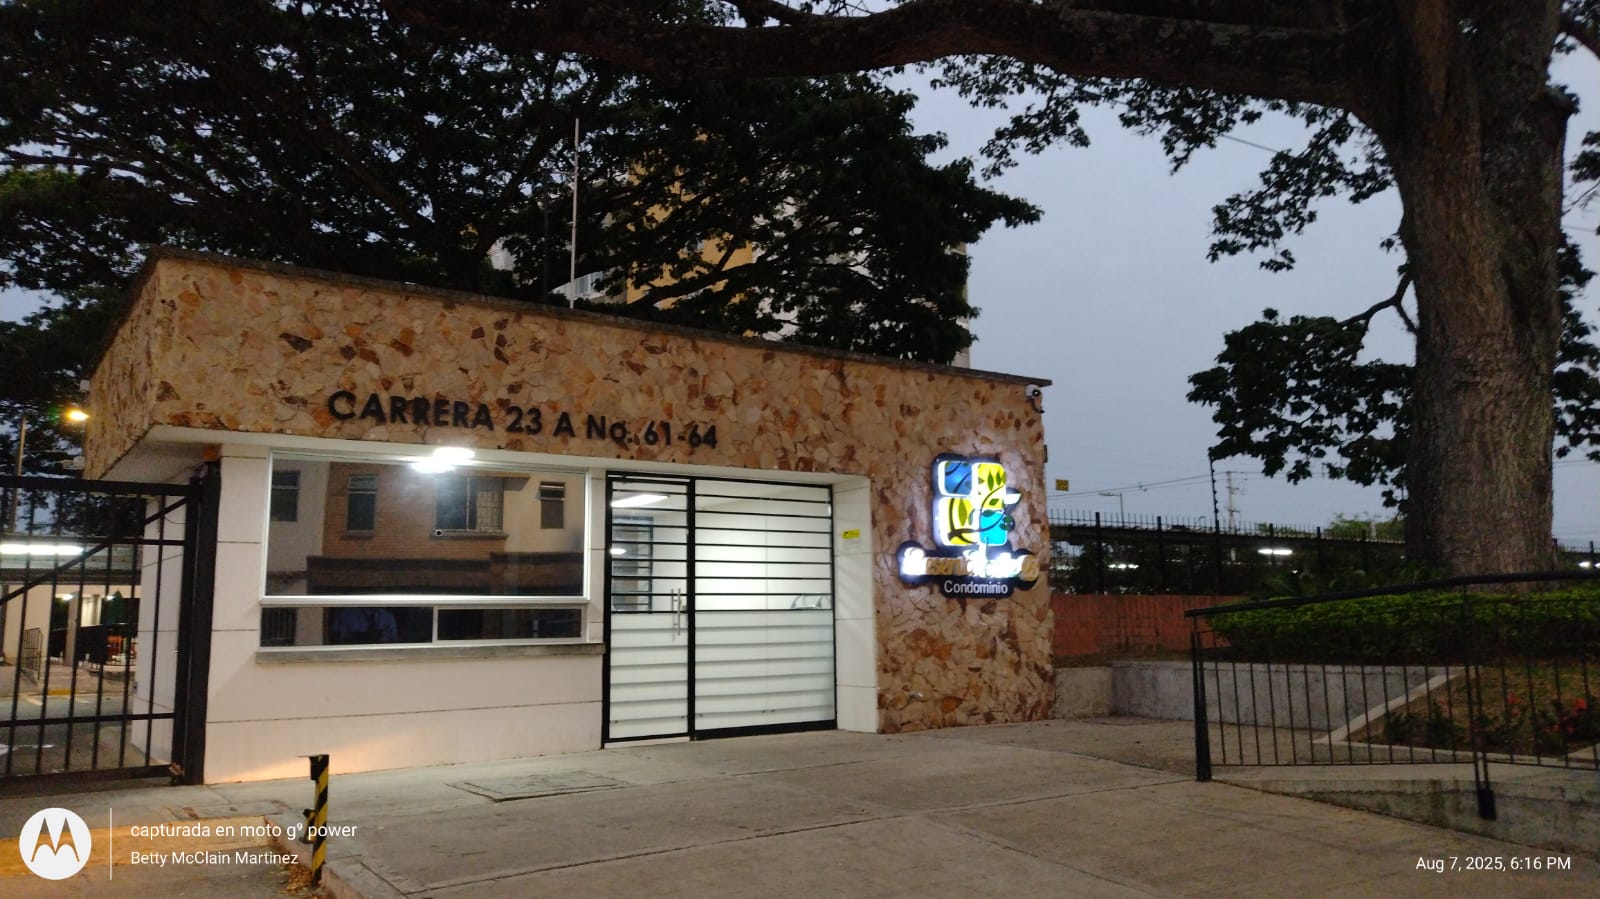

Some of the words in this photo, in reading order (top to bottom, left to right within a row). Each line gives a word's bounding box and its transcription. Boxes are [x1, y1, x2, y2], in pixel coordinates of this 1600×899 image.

[328, 390, 494, 431] CARRERA
[506, 405, 542, 435] 23
[552, 411, 576, 438] A
[586, 414, 634, 443] No.
[645, 420, 718, 449] 61-64
[943, 579, 1009, 594] Condominio
